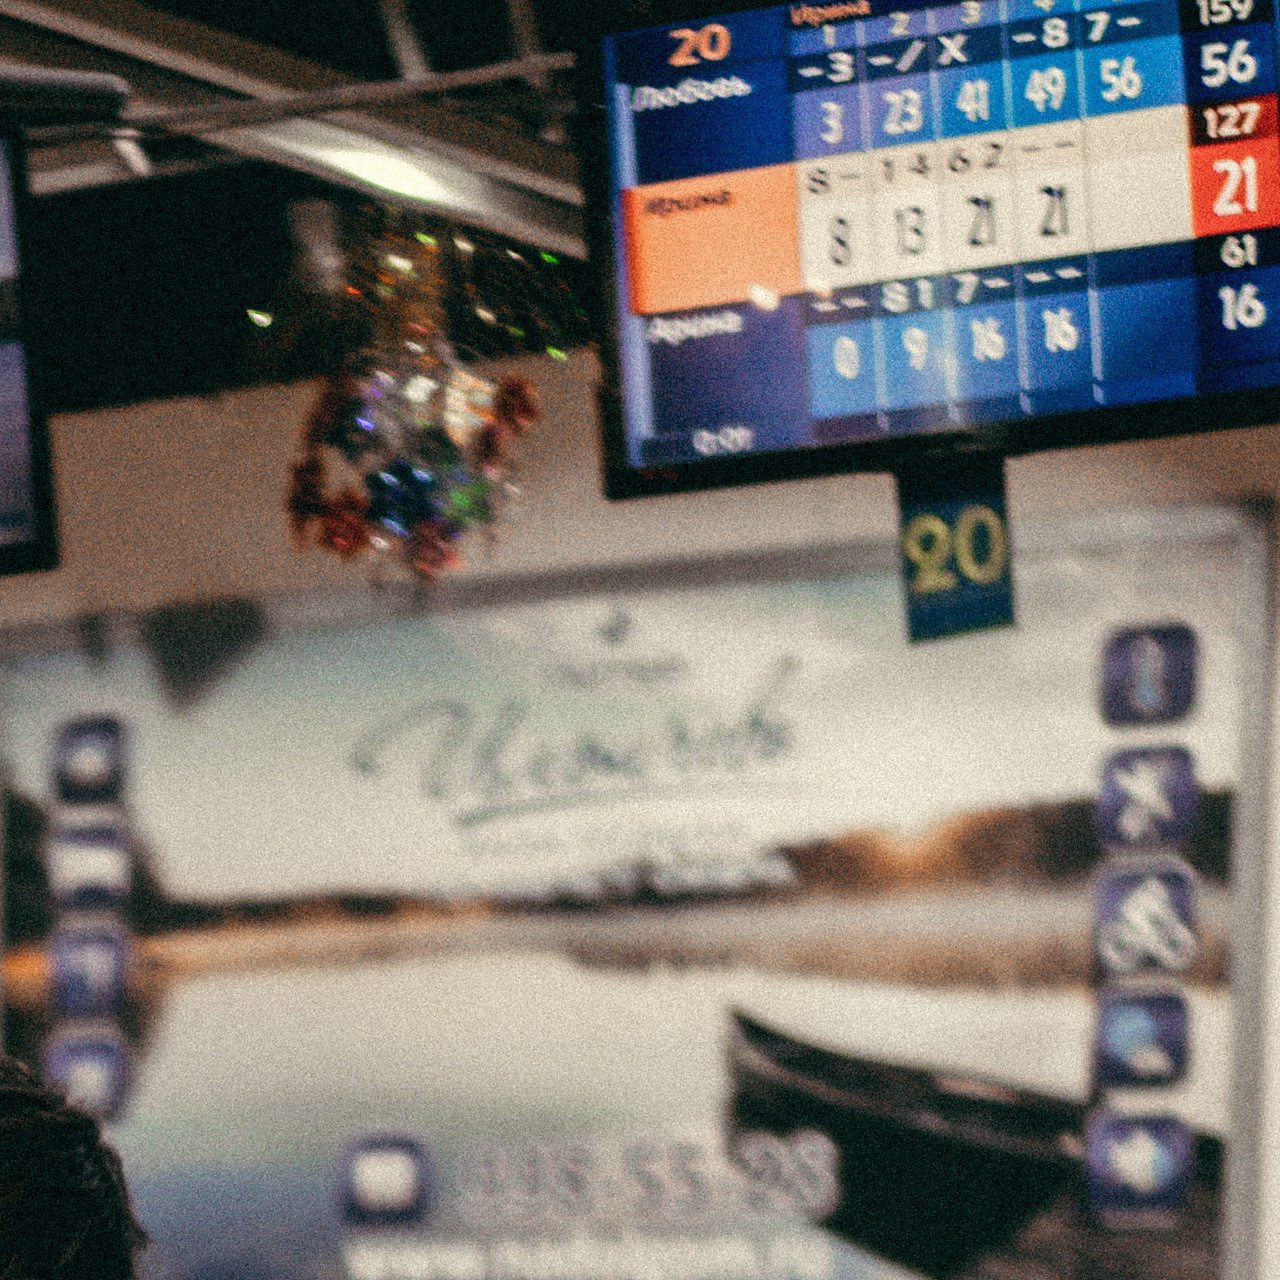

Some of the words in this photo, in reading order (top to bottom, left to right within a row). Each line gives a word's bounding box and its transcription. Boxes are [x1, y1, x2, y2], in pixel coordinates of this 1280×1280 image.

[890, 11, 911, 36] 2
[1195, 0, 1256, 26] 159
[668, 22, 732, 68] 20
[938, 32, 968, 66] X
[1201, 39, 1258, 88] 56
[820, 100, 844, 145] 3
[883, 88, 924, 135] 23
[954, 78, 991, 122] 41
[1024, 66, 1068, 113] 49
[1099, 56, 1143, 102] 56
[1203, 102, 1262, 139] 127
[1212, 155, 1259, 217] 21
[894, 204, 927, 257] 13
[967, 194, 998, 248] 21
[1038, 183, 1070, 238] 21
[1220, 232, 1259, 269] 61
[1219, 282, 1266, 331] 16
[901, 325, 929, 371] 9
[969, 316, 1007, 362] 16
[1041, 306, 1080, 353] 16
[903, 503, 1008, 595] 20
